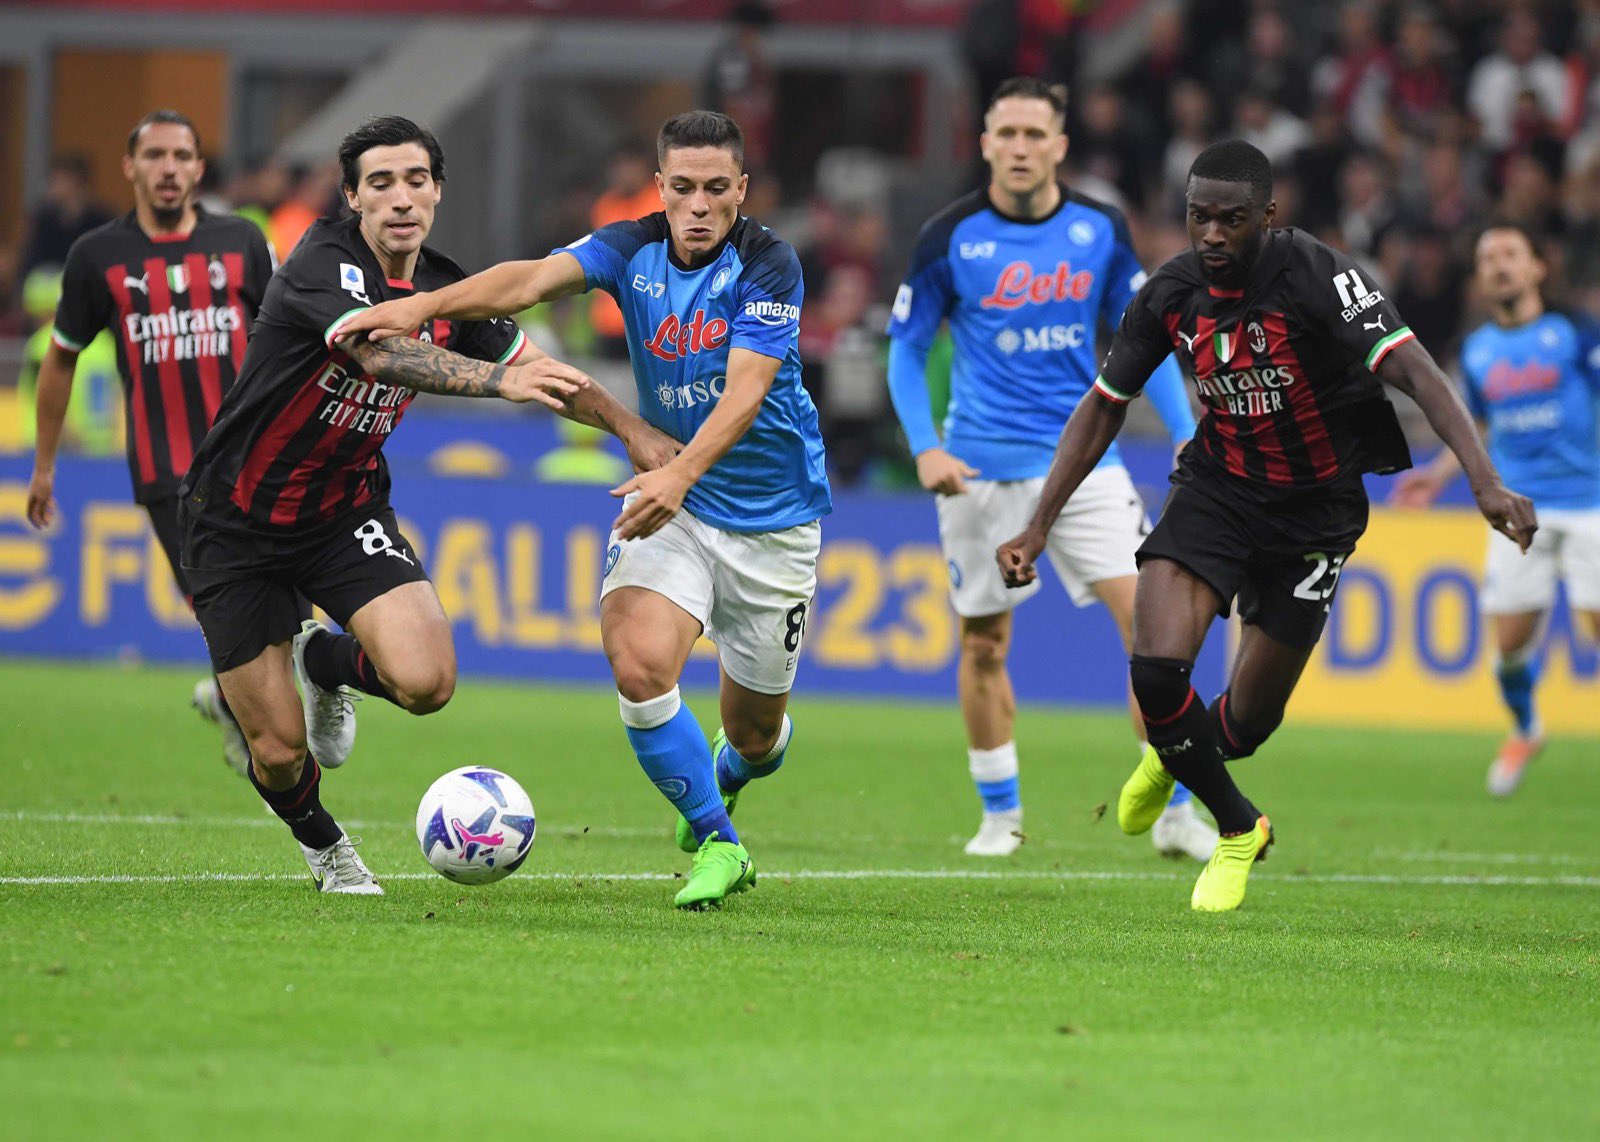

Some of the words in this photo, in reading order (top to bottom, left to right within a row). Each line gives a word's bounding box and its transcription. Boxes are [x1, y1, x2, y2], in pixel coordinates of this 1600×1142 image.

[632, 273, 666, 299] EA7
[980, 260, 1094, 310] Lete
[125, 304, 242, 343] Emirates
[1341, 290, 1385, 323] BitMEX
[144, 337, 170, 365] FLY
[173, 330, 231, 361] BETTER
[643, 308, 729, 362] Lete
[1023, 323, 1086, 353] MSC
[676, 375, 727, 408] MSC
[1197, 365, 1295, 395] mirates
[319, 400, 355, 427] FLY
[1226, 390, 1283, 416] BETTER
[353, 518, 393, 556] 8
[1293, 552, 1346, 601] 23
[784, 598, 814, 653] 8
